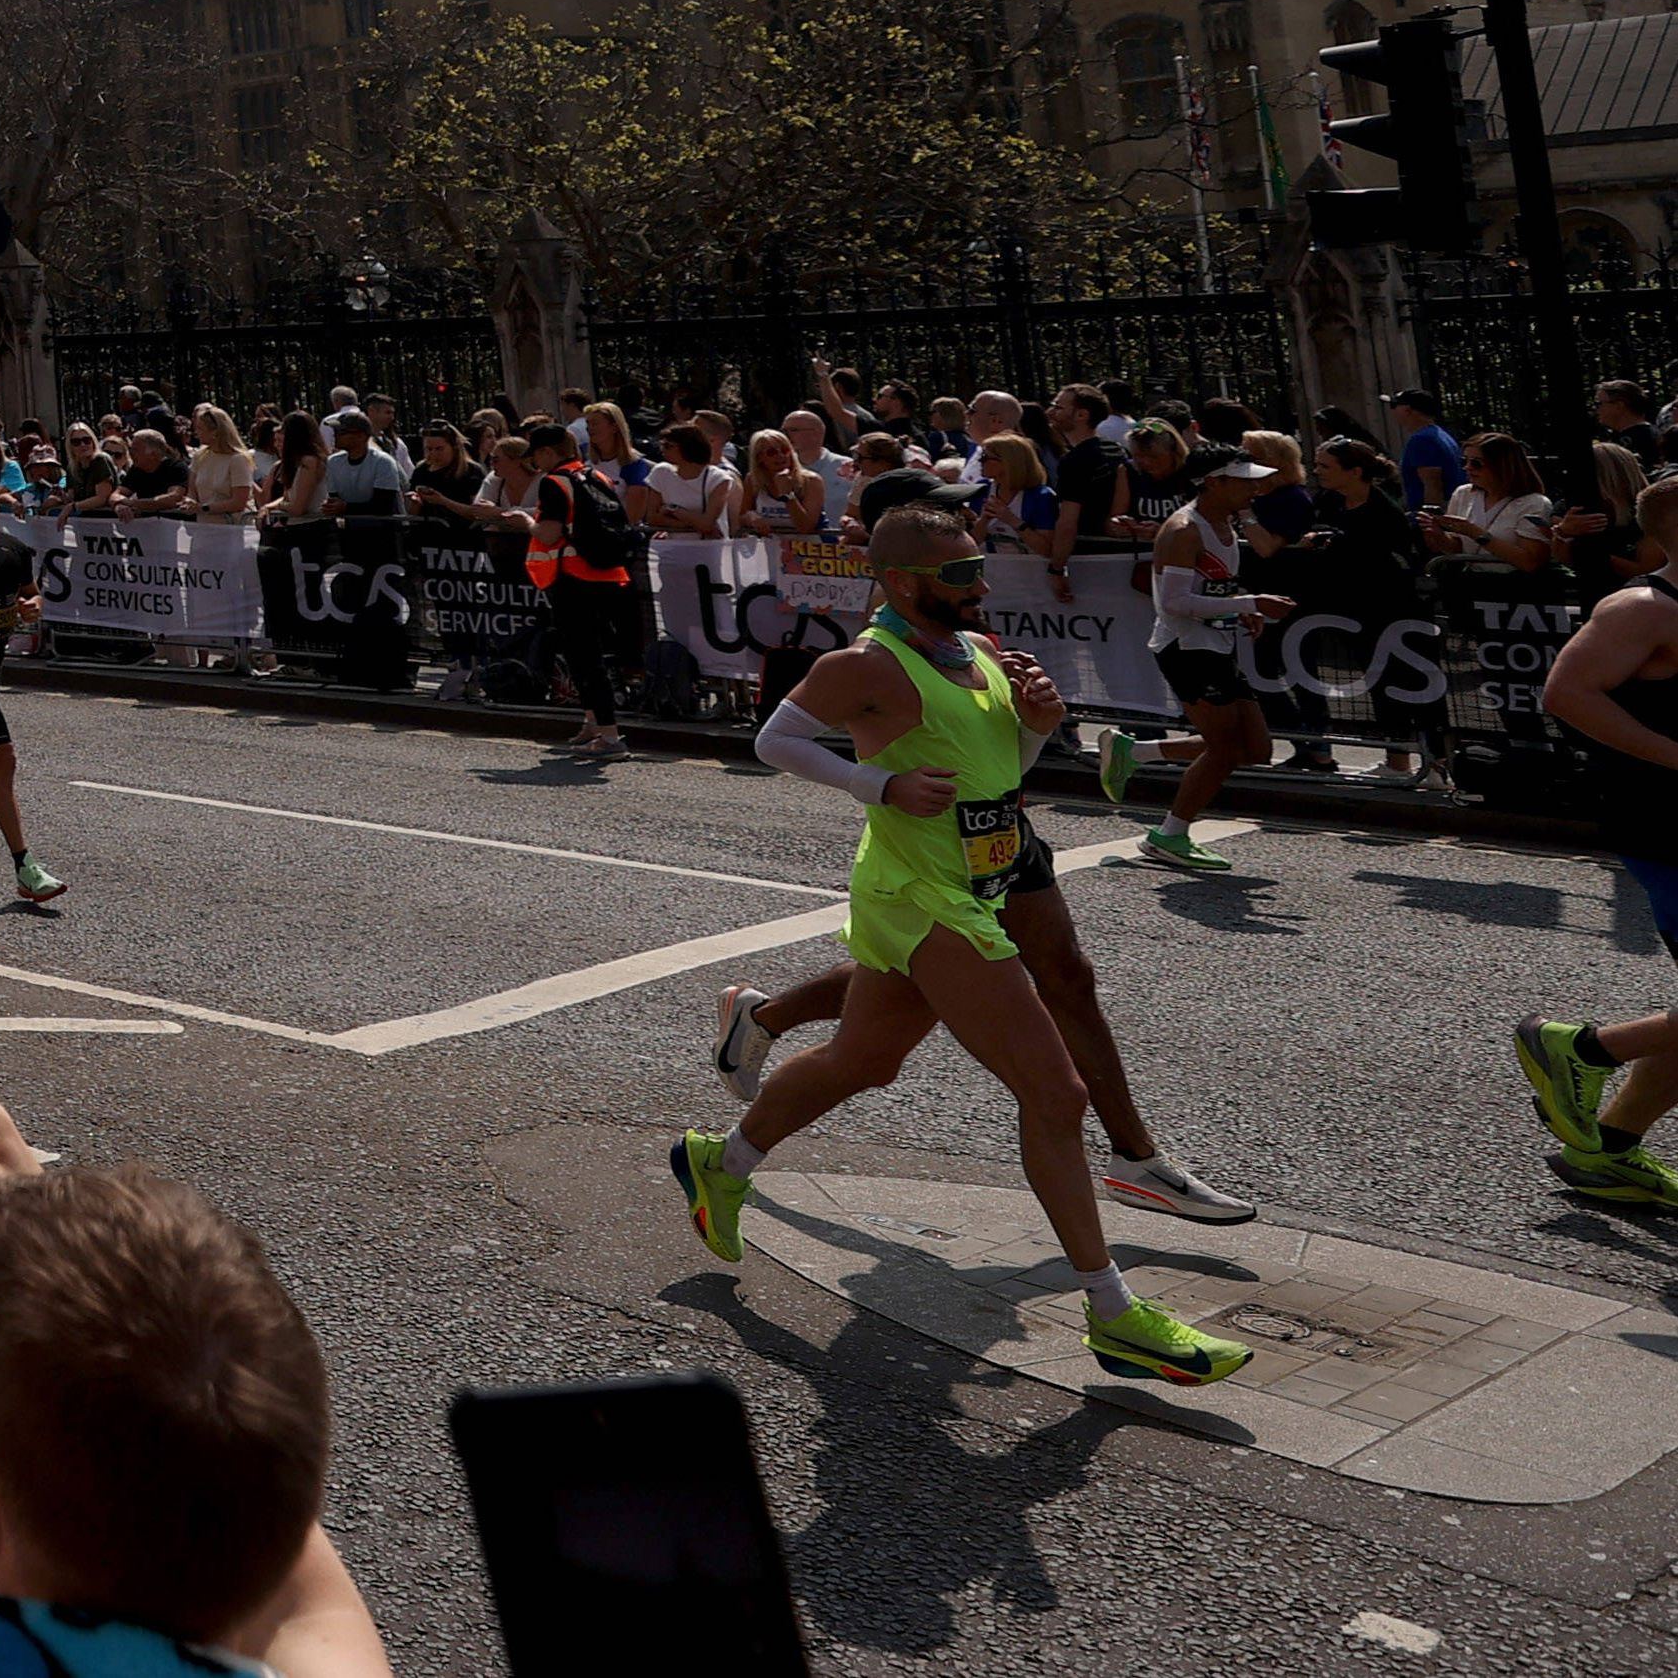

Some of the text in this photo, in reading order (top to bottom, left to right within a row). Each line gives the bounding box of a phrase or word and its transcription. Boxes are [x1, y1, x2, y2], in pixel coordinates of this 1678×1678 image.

[83, 535, 145, 557] TATA
[791, 540, 851, 558] KEEP
[421, 546, 495, 573] TATA
[802, 558, 877, 579] GOING
[84, 560, 225, 590] CONSULTANCY
[290, 546, 411, 625] tcs
[84, 586, 175, 615] SERVICES
[791, 582, 847, 601] DADDY
[1472, 601, 1591, 634] TAT
[961, 805, 998, 831] tcs
